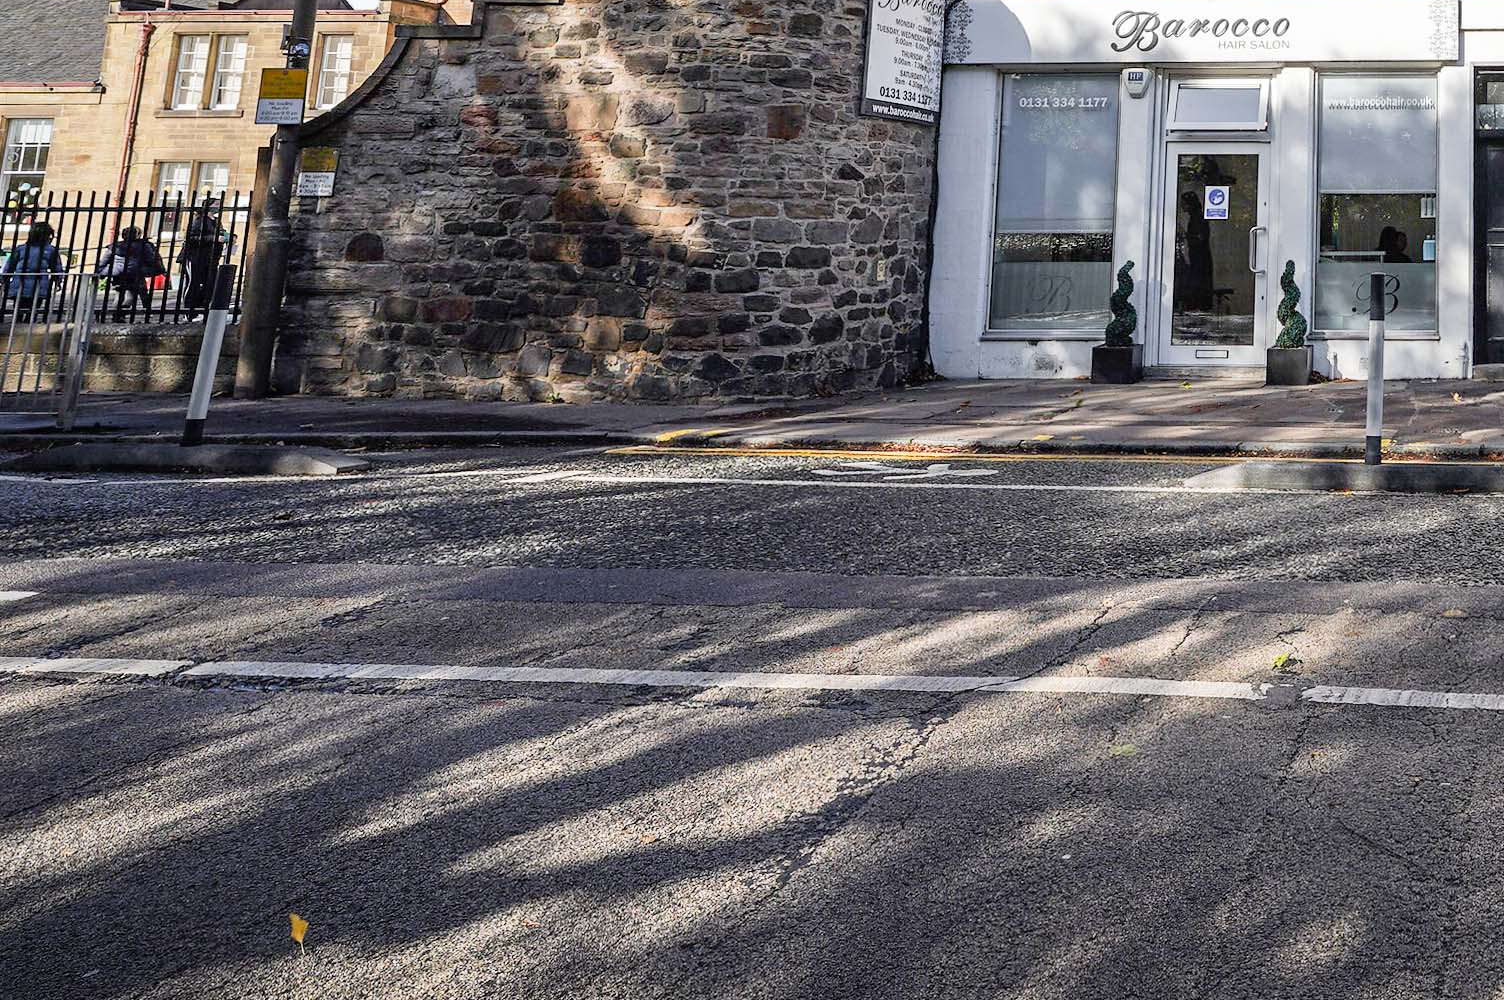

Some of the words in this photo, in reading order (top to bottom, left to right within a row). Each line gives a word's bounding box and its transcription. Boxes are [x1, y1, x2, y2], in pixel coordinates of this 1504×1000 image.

[1110, 10, 1290, 52] Barocco
[1218, 40, 1246, 49] HAIR
[1250, 40, 1290, 49] SALON
[880, 86, 901, 101] 0131
[902, 90, 916, 103] 334
[1019, 97, 1049, 108] 0131
[1052, 97, 1076, 108] 334
[1078, 97, 1108, 108] 1177
[1324, 96, 1434, 108] www.baroccohair.co.uk
